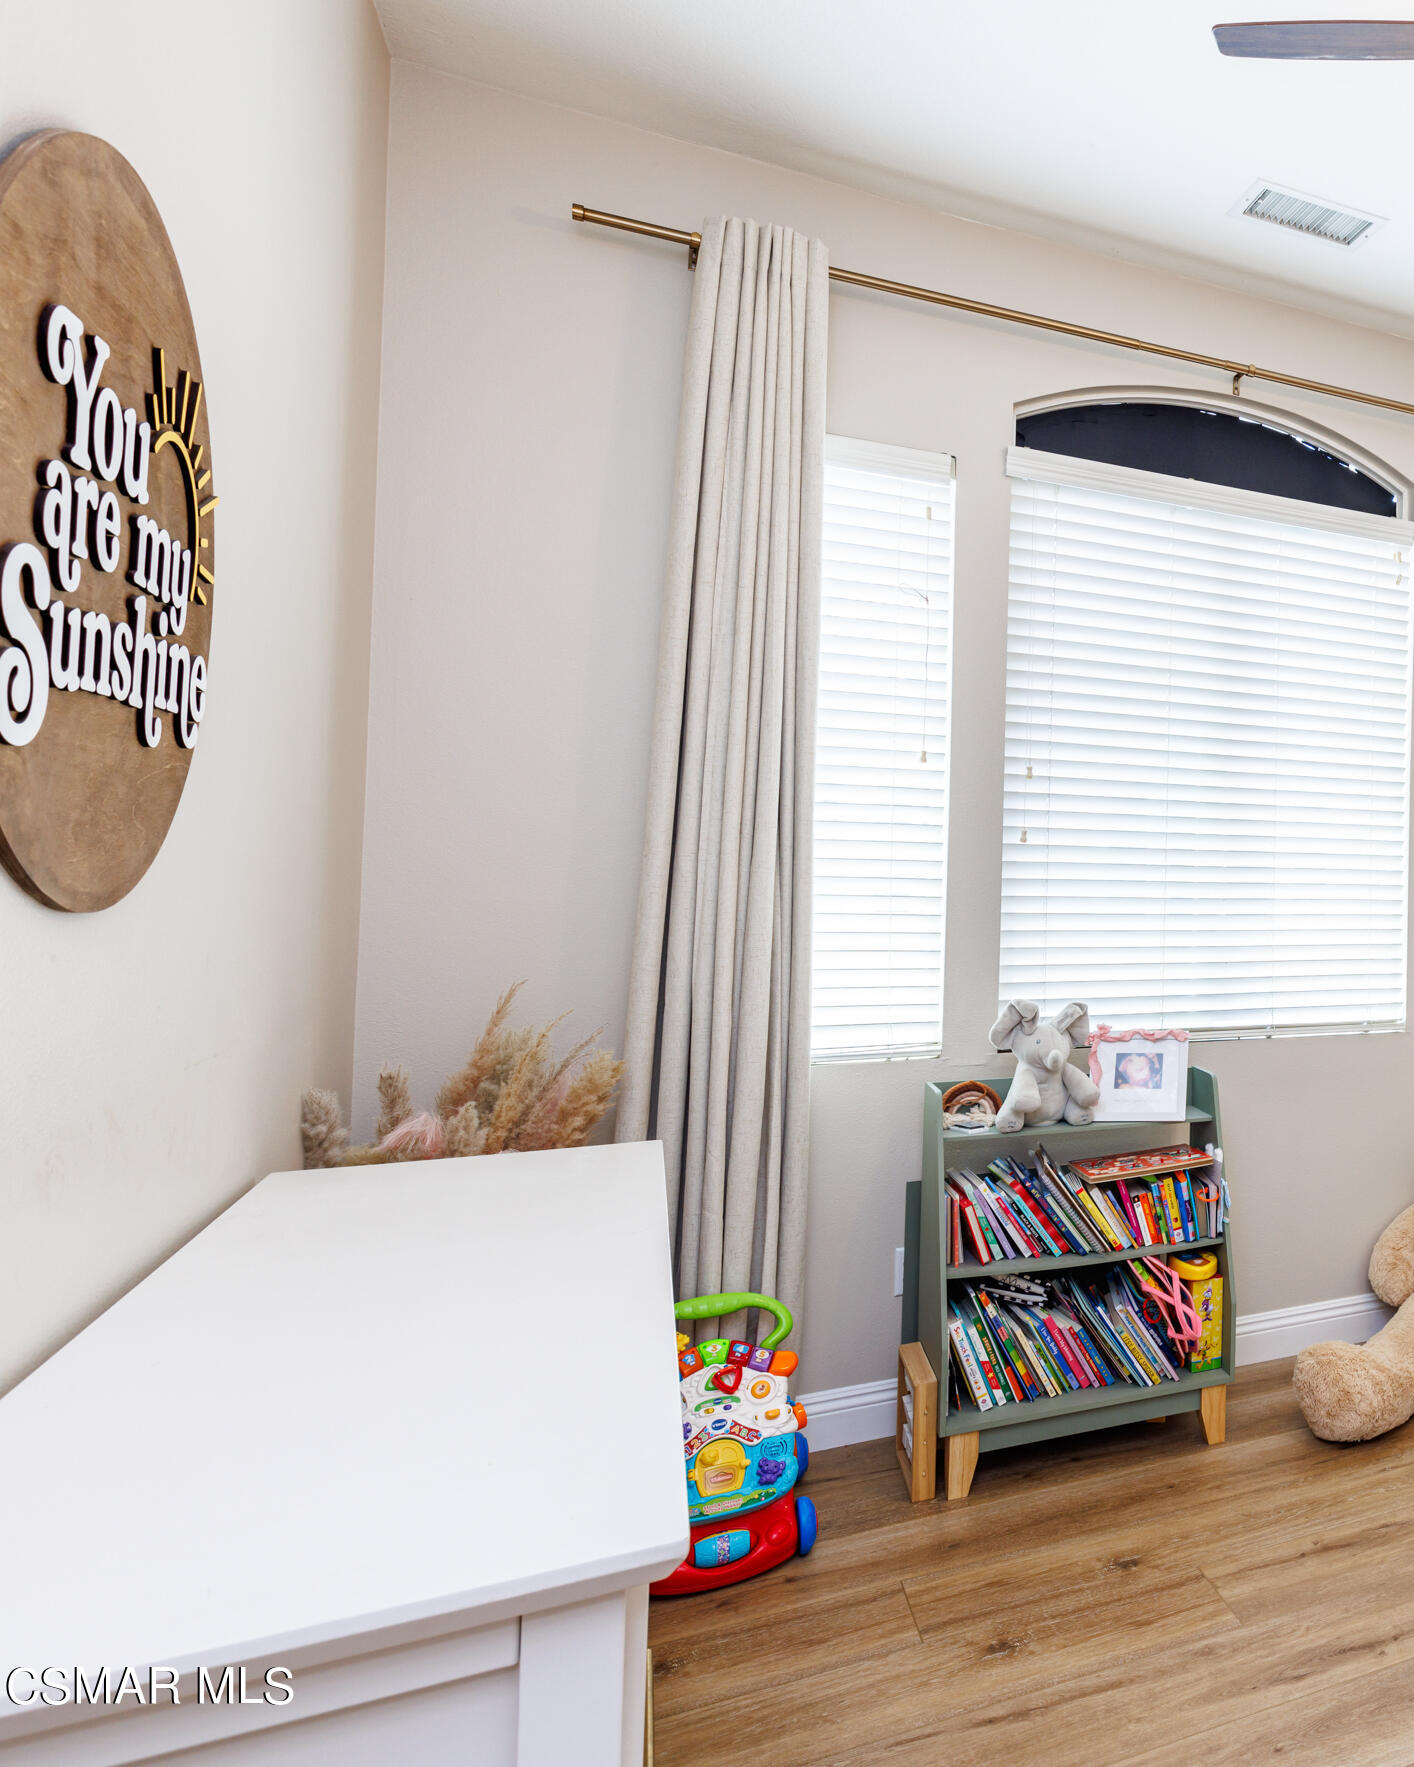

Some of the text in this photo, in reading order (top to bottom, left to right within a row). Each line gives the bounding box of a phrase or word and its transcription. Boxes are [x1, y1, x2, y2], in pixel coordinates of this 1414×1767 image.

[46, 305, 150, 504] You
[0, 542, 206, 748] Sunshine
[42, 459, 191, 635] are my
